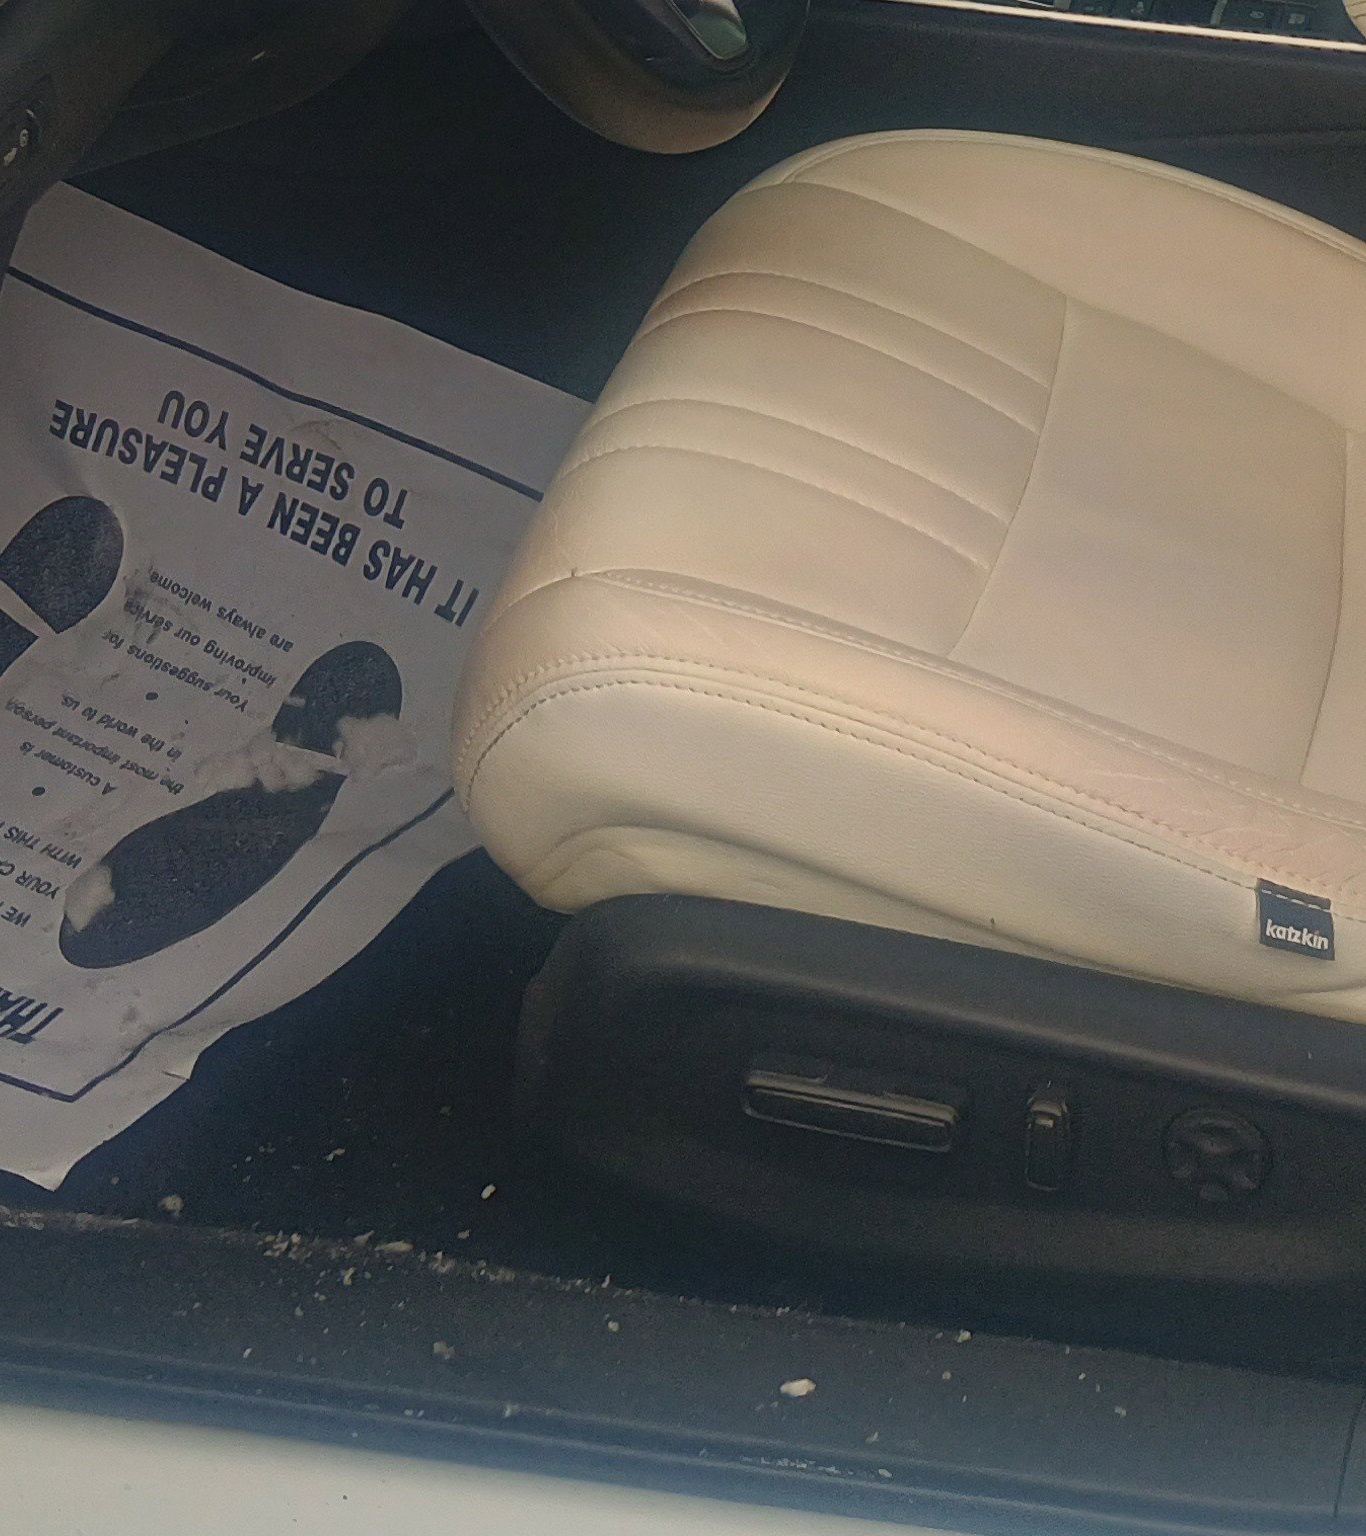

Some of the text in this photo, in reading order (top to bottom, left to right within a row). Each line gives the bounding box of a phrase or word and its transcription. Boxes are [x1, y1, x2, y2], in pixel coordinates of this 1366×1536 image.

[157, 390, 408, 530] TO SERVE YOU
[49, 399, 480, 628] IT HAS BEEN A PLEASURE
[217, 607, 266, 638] always
[123, 600, 276, 688] improving our service
[269, 634, 294, 652] are
[101, 629, 248, 713] Your suggestions for
[82, 707, 98, 721] to
[96, 714, 138, 738] world
[52, 727, 121, 764] important
[141, 734, 165, 752] the
[167, 747, 182, 762] in
[19, 742, 117, 795] A customer is
[119, 760, 159, 780] most
[160, 778, 184, 795] the
[3, 826, 40, 850] THIS
[39, 843, 82, 869] WITH
[15, 871, 60, 899] YOUR
[1, 906, 31, 927] WE
[1266, 918, 1329, 951] katzkin
